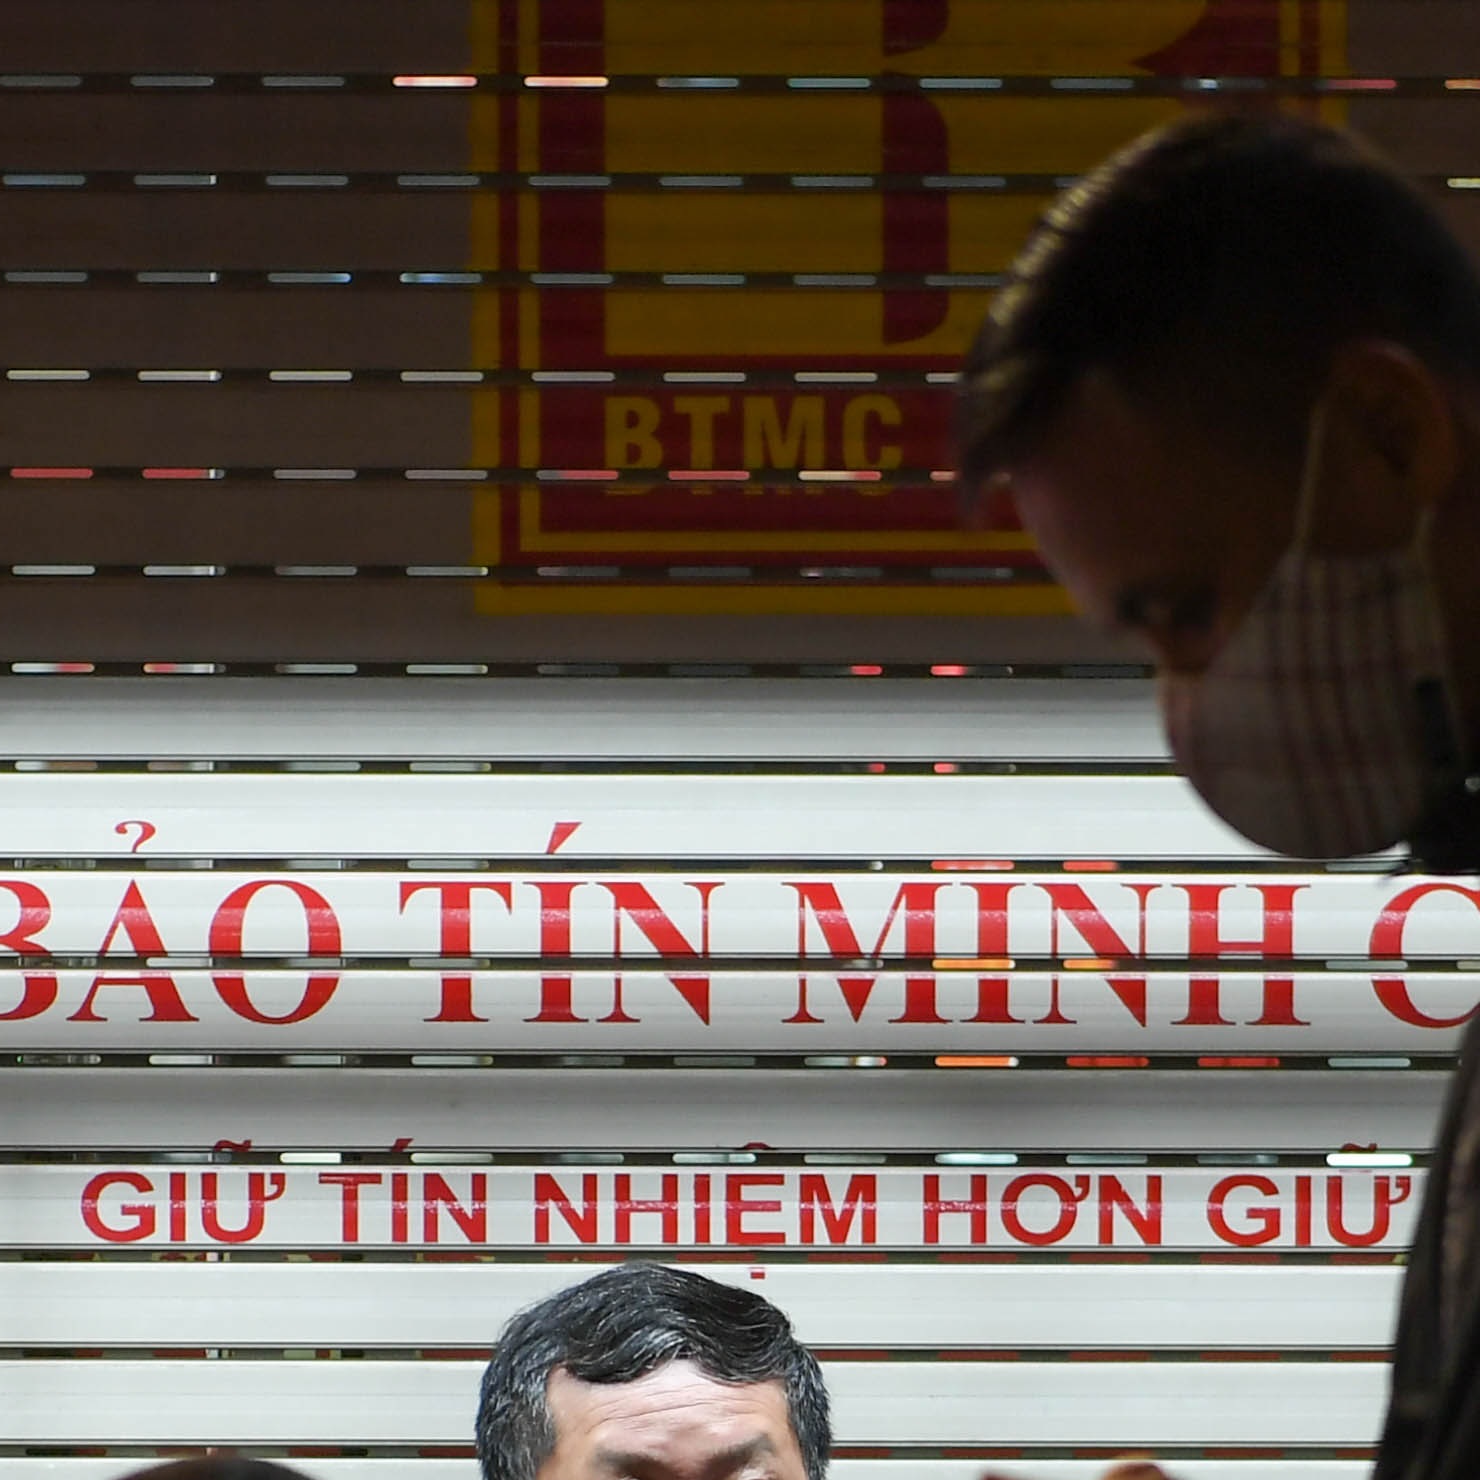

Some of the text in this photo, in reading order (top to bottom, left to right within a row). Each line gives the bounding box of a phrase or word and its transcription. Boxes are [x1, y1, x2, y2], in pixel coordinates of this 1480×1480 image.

[603, 393, 905, 496] BTMC
[400, 821, 724, 1026] TÍN
[781, 881, 1312, 1028] MINH
[82, 1140, 286, 1244] GIỮ
[319, 1138, 488, 1244] TÍN
[535, 1142, 877, 1280] NHIỆM
[923, 1172, 1164, 1248] HƠN
